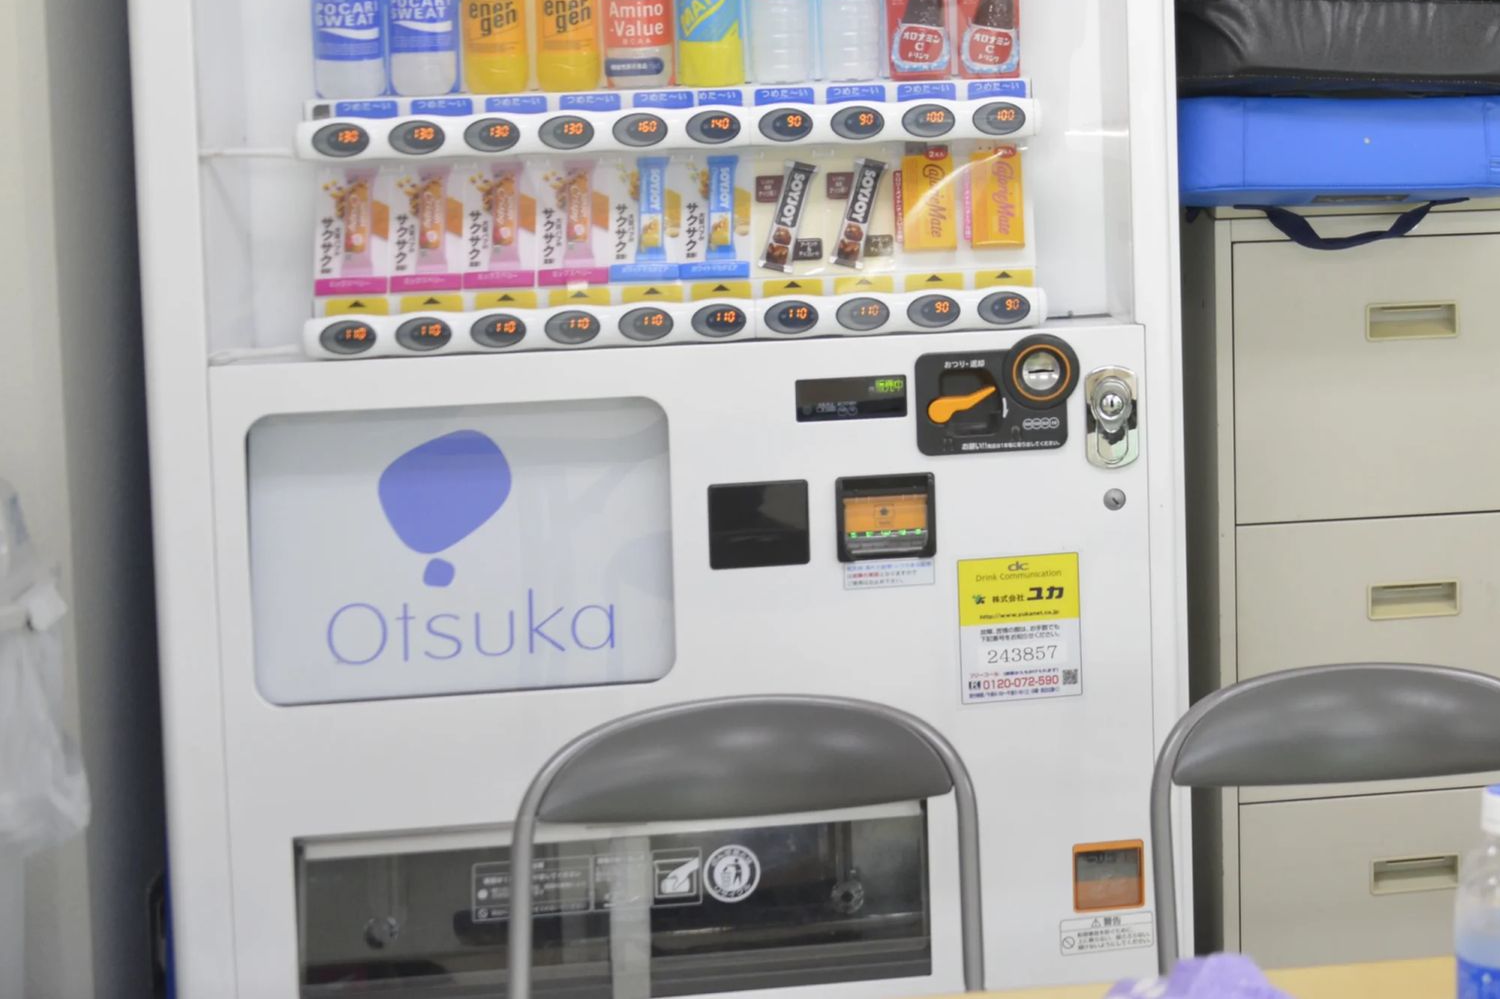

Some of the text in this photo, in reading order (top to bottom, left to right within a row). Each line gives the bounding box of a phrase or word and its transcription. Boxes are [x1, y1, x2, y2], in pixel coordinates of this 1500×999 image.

[469, 0, 514, 19] ener
[544, 0, 588, 16] ener
[609, 1, 664, 17] Amino
[480, 8, 517, 37] gen
[555, 5, 591, 33] gen
[710, 117, 730, 130] 140
[787, 115, 802, 128] 90
[859, 113, 874, 126] 90
[927, 111, 944, 123] 100
[997, 109, 1015, 121] 100
[563, 122, 583, 135] 130
[637, 120, 658, 133] 160
[719, 167, 730, 210] SOYJOY
[852, 169, 877, 223] SOYJOY
[781, 172, 805, 226] SOYJOY
[469, 210, 482, 260] サクサク
[543, 208, 555, 258] サクサク
[615, 203, 628, 253] サクサク
[686, 202, 699, 252] サクサク
[321, 217, 333, 267] サクサク
[396, 214, 408, 264] サクサク
[860, 304, 880, 316] 110
[935, 301, 949, 313] 90
[1005, 298, 1020, 310] 90
[716, 311, 736, 323] 110
[788, 307, 808, 319] 110
[326, 588, 616, 666] Otsuka
[987, 645, 1058, 664] 243857
